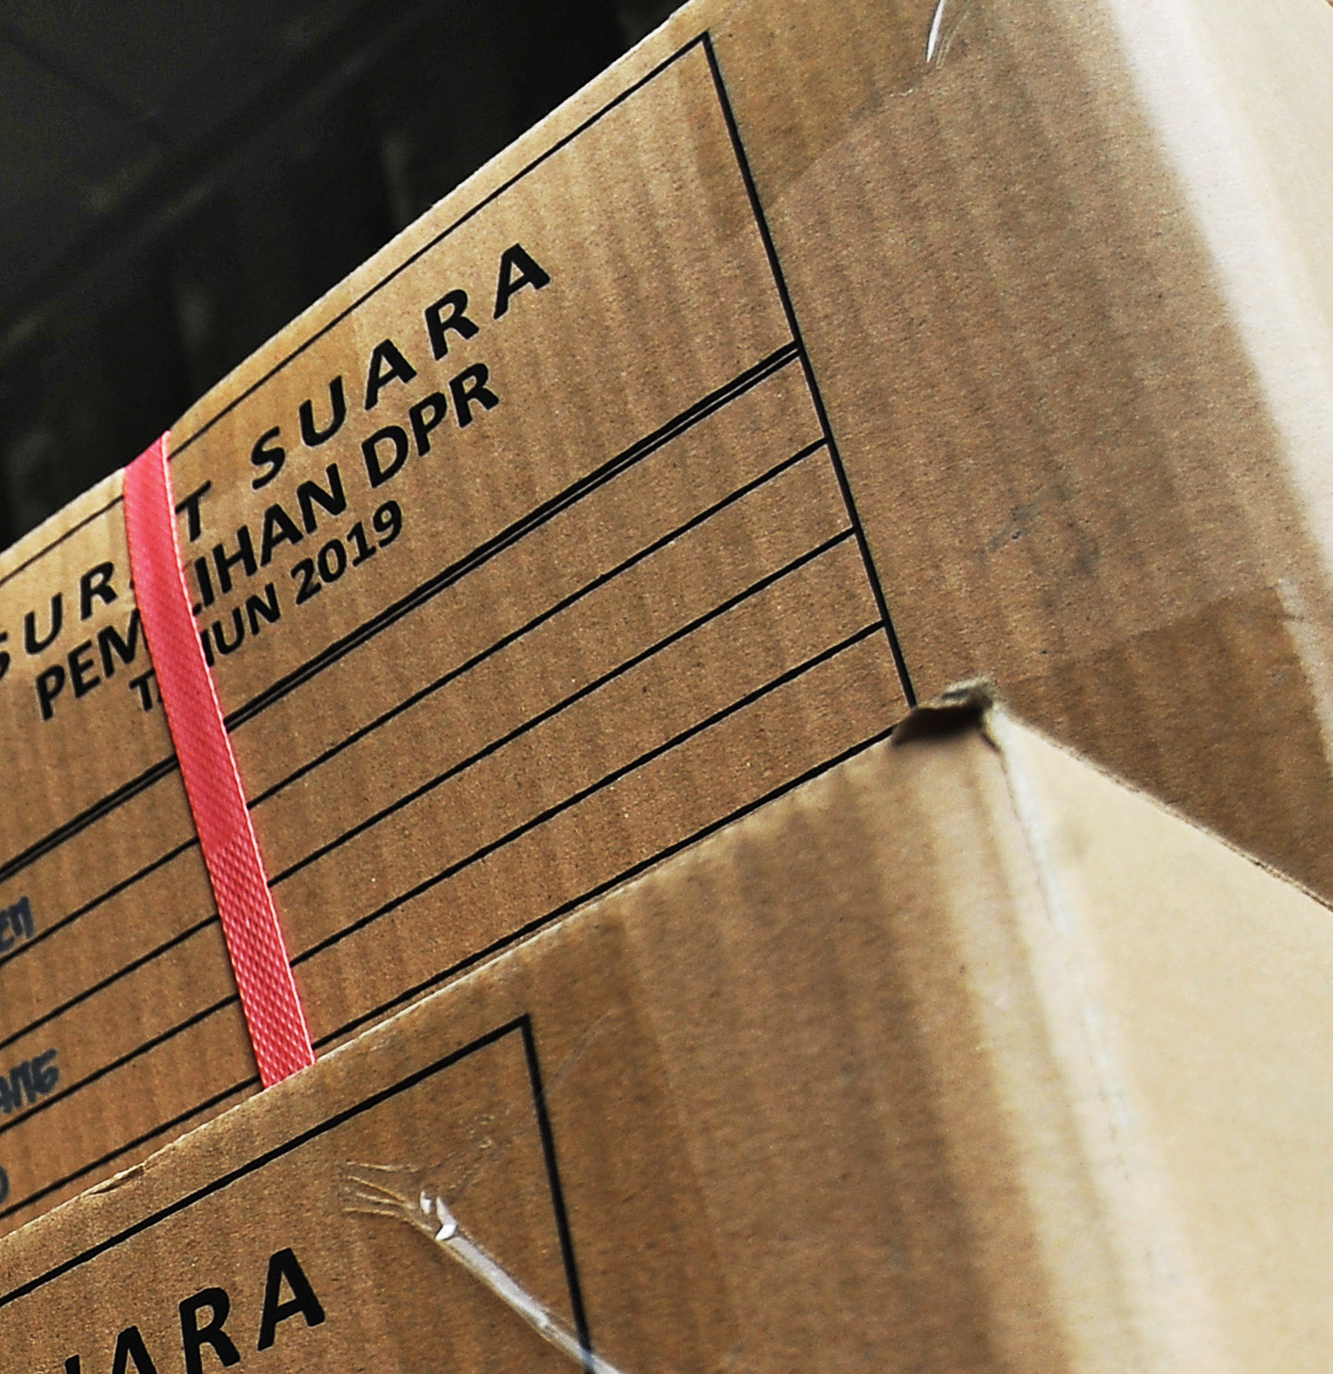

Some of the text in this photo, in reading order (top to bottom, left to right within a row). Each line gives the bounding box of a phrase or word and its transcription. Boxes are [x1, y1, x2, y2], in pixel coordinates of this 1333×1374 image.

[250, 242, 551, 491] SUARA
[35, 362, 501, 720] PEMIHAN DPR
[129, 498, 404, 712] TUN 2019
